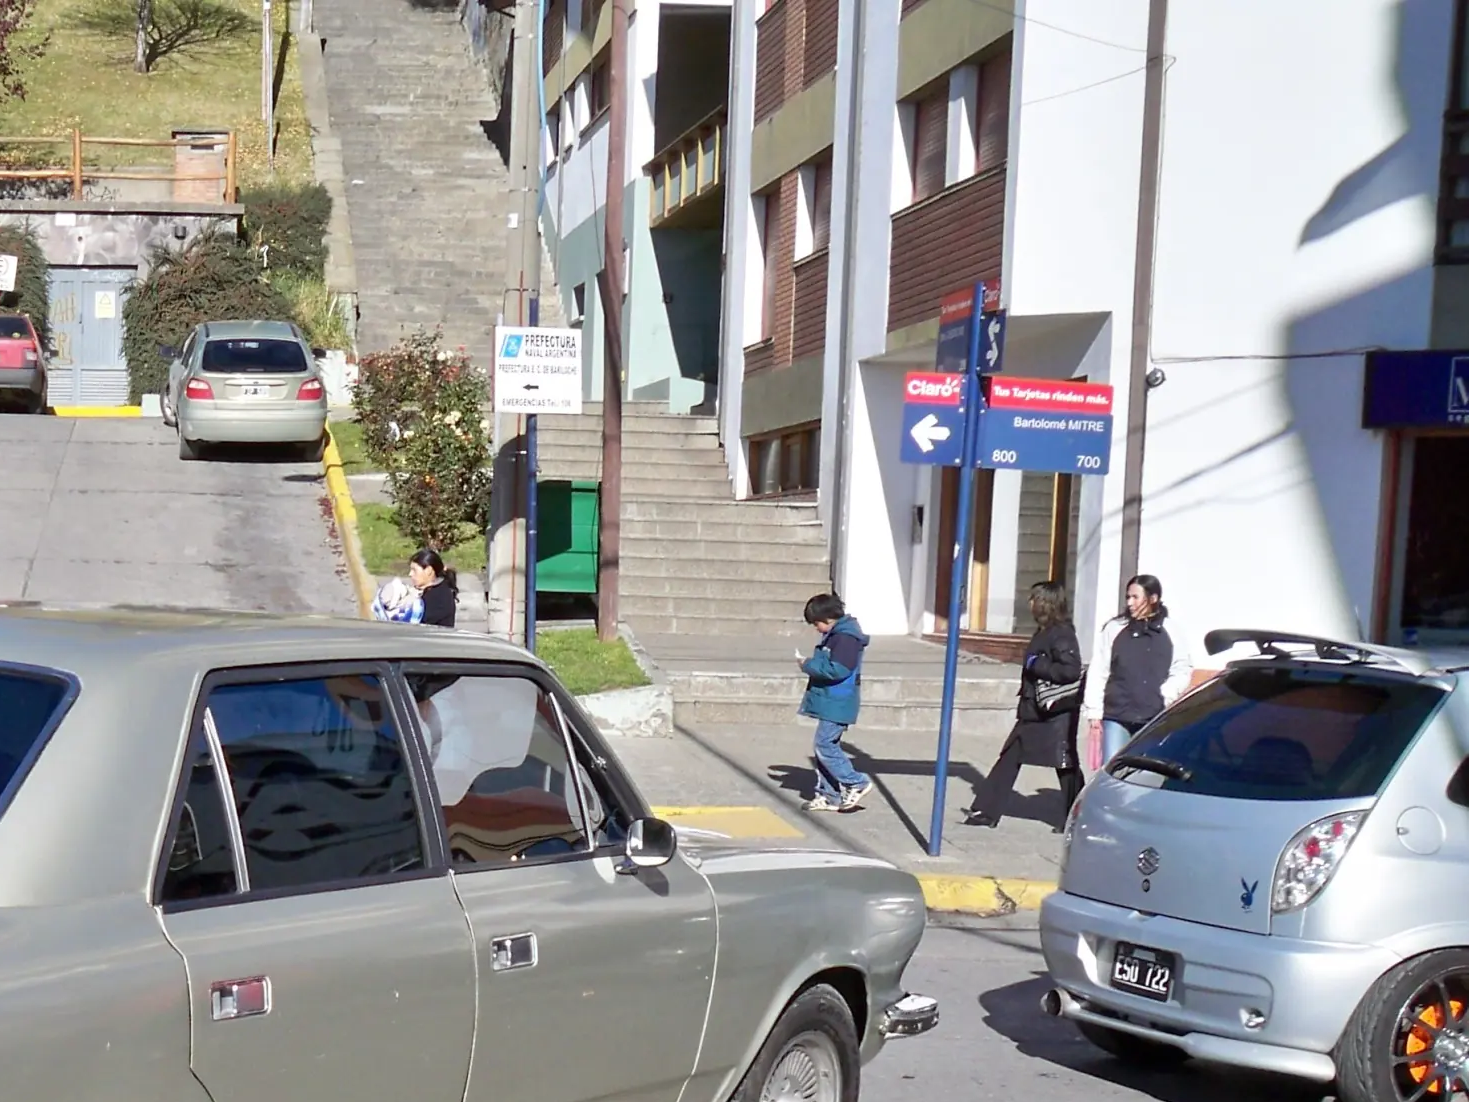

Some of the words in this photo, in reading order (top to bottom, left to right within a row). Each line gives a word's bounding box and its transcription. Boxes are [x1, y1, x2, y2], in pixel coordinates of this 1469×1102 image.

[525, 334, 577, 349] PREFECTURA
[525, 349, 544, 358] NAVAL
[545, 349, 577, 359] ARGENTINA
[907, 378, 955, 397] Claro
[994, 385, 1011, 397] Tus
[1012, 387, 1051, 401] Tarjetas
[1052, 390, 1084, 403] rinden
[1086, 393, 1110, 405] más.
[502, 398, 546, 407] EMERGENCIAS
[1013, 416, 1067, 430] Bartolomé
[1068, 419, 1105, 432] MITRE
[992, 449, 1017, 463] 800
[1076, 455, 1101, 468] 700
[1145, 962, 1170, 992] 722
